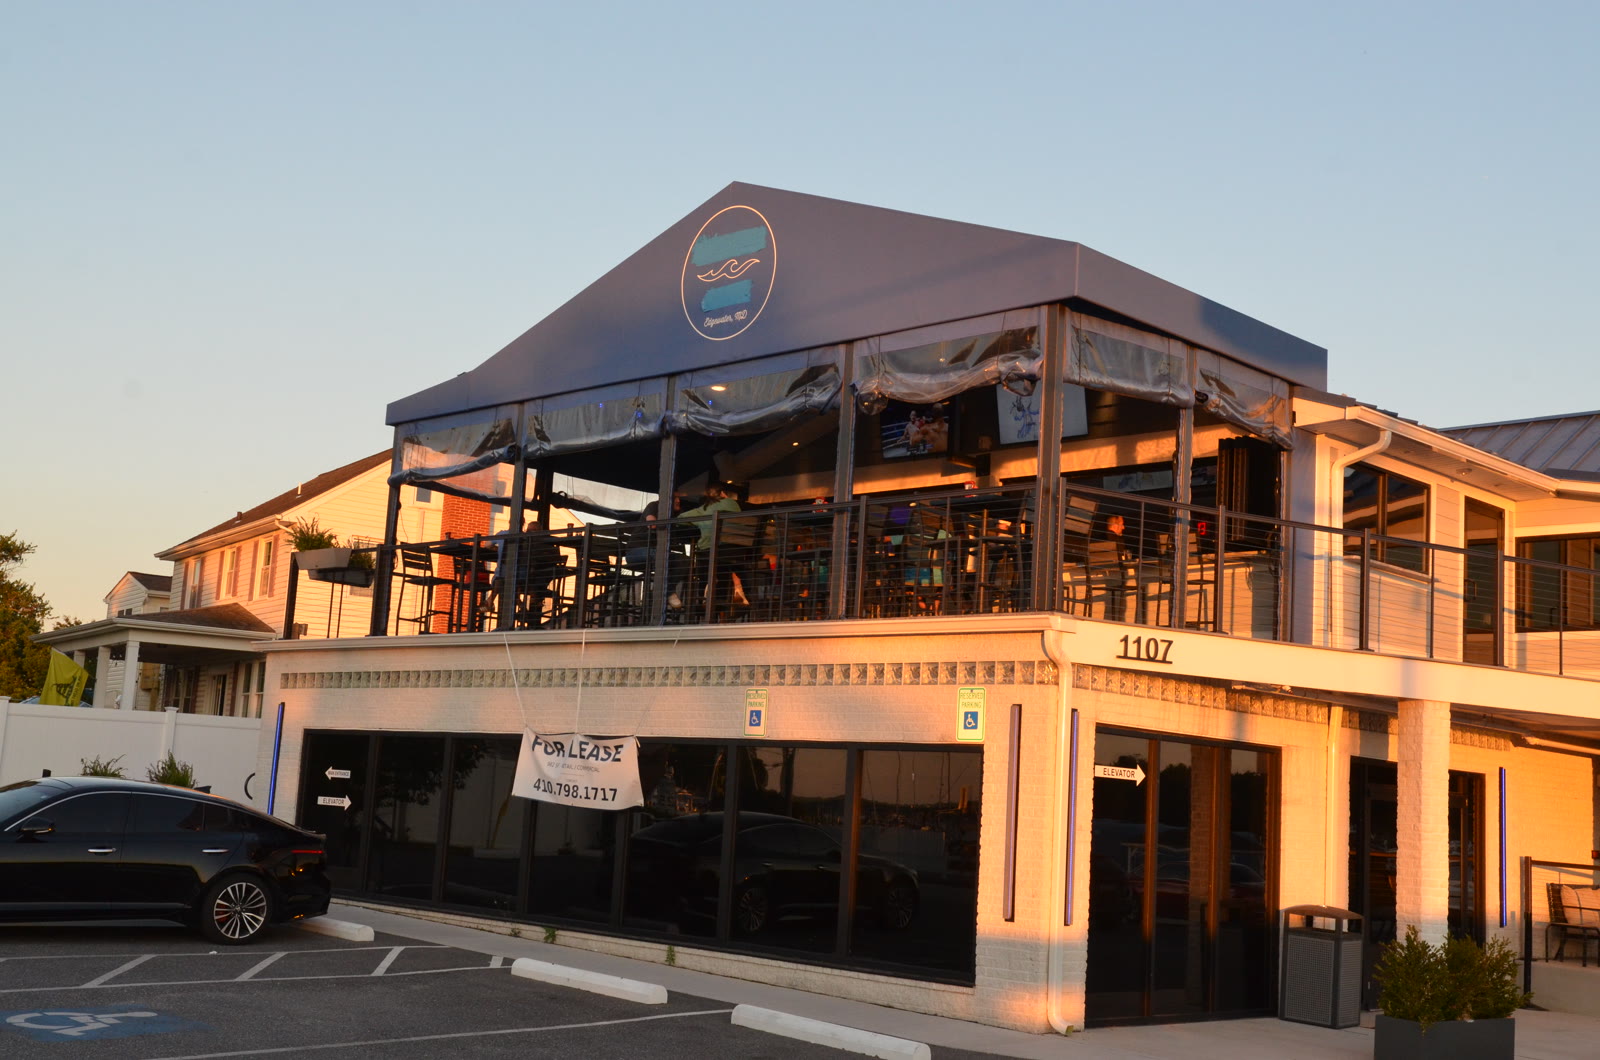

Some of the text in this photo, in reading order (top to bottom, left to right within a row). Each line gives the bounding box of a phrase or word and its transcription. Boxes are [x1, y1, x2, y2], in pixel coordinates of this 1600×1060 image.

[1119, 634, 1174, 662] 1107
[532, 735, 624, 762] FOR LEASE
[1102, 767, 1136, 778] ELEVATOR
[322, 797, 345, 805] ELEVATOR
[533, 778, 618, 802] 410.798.1717
